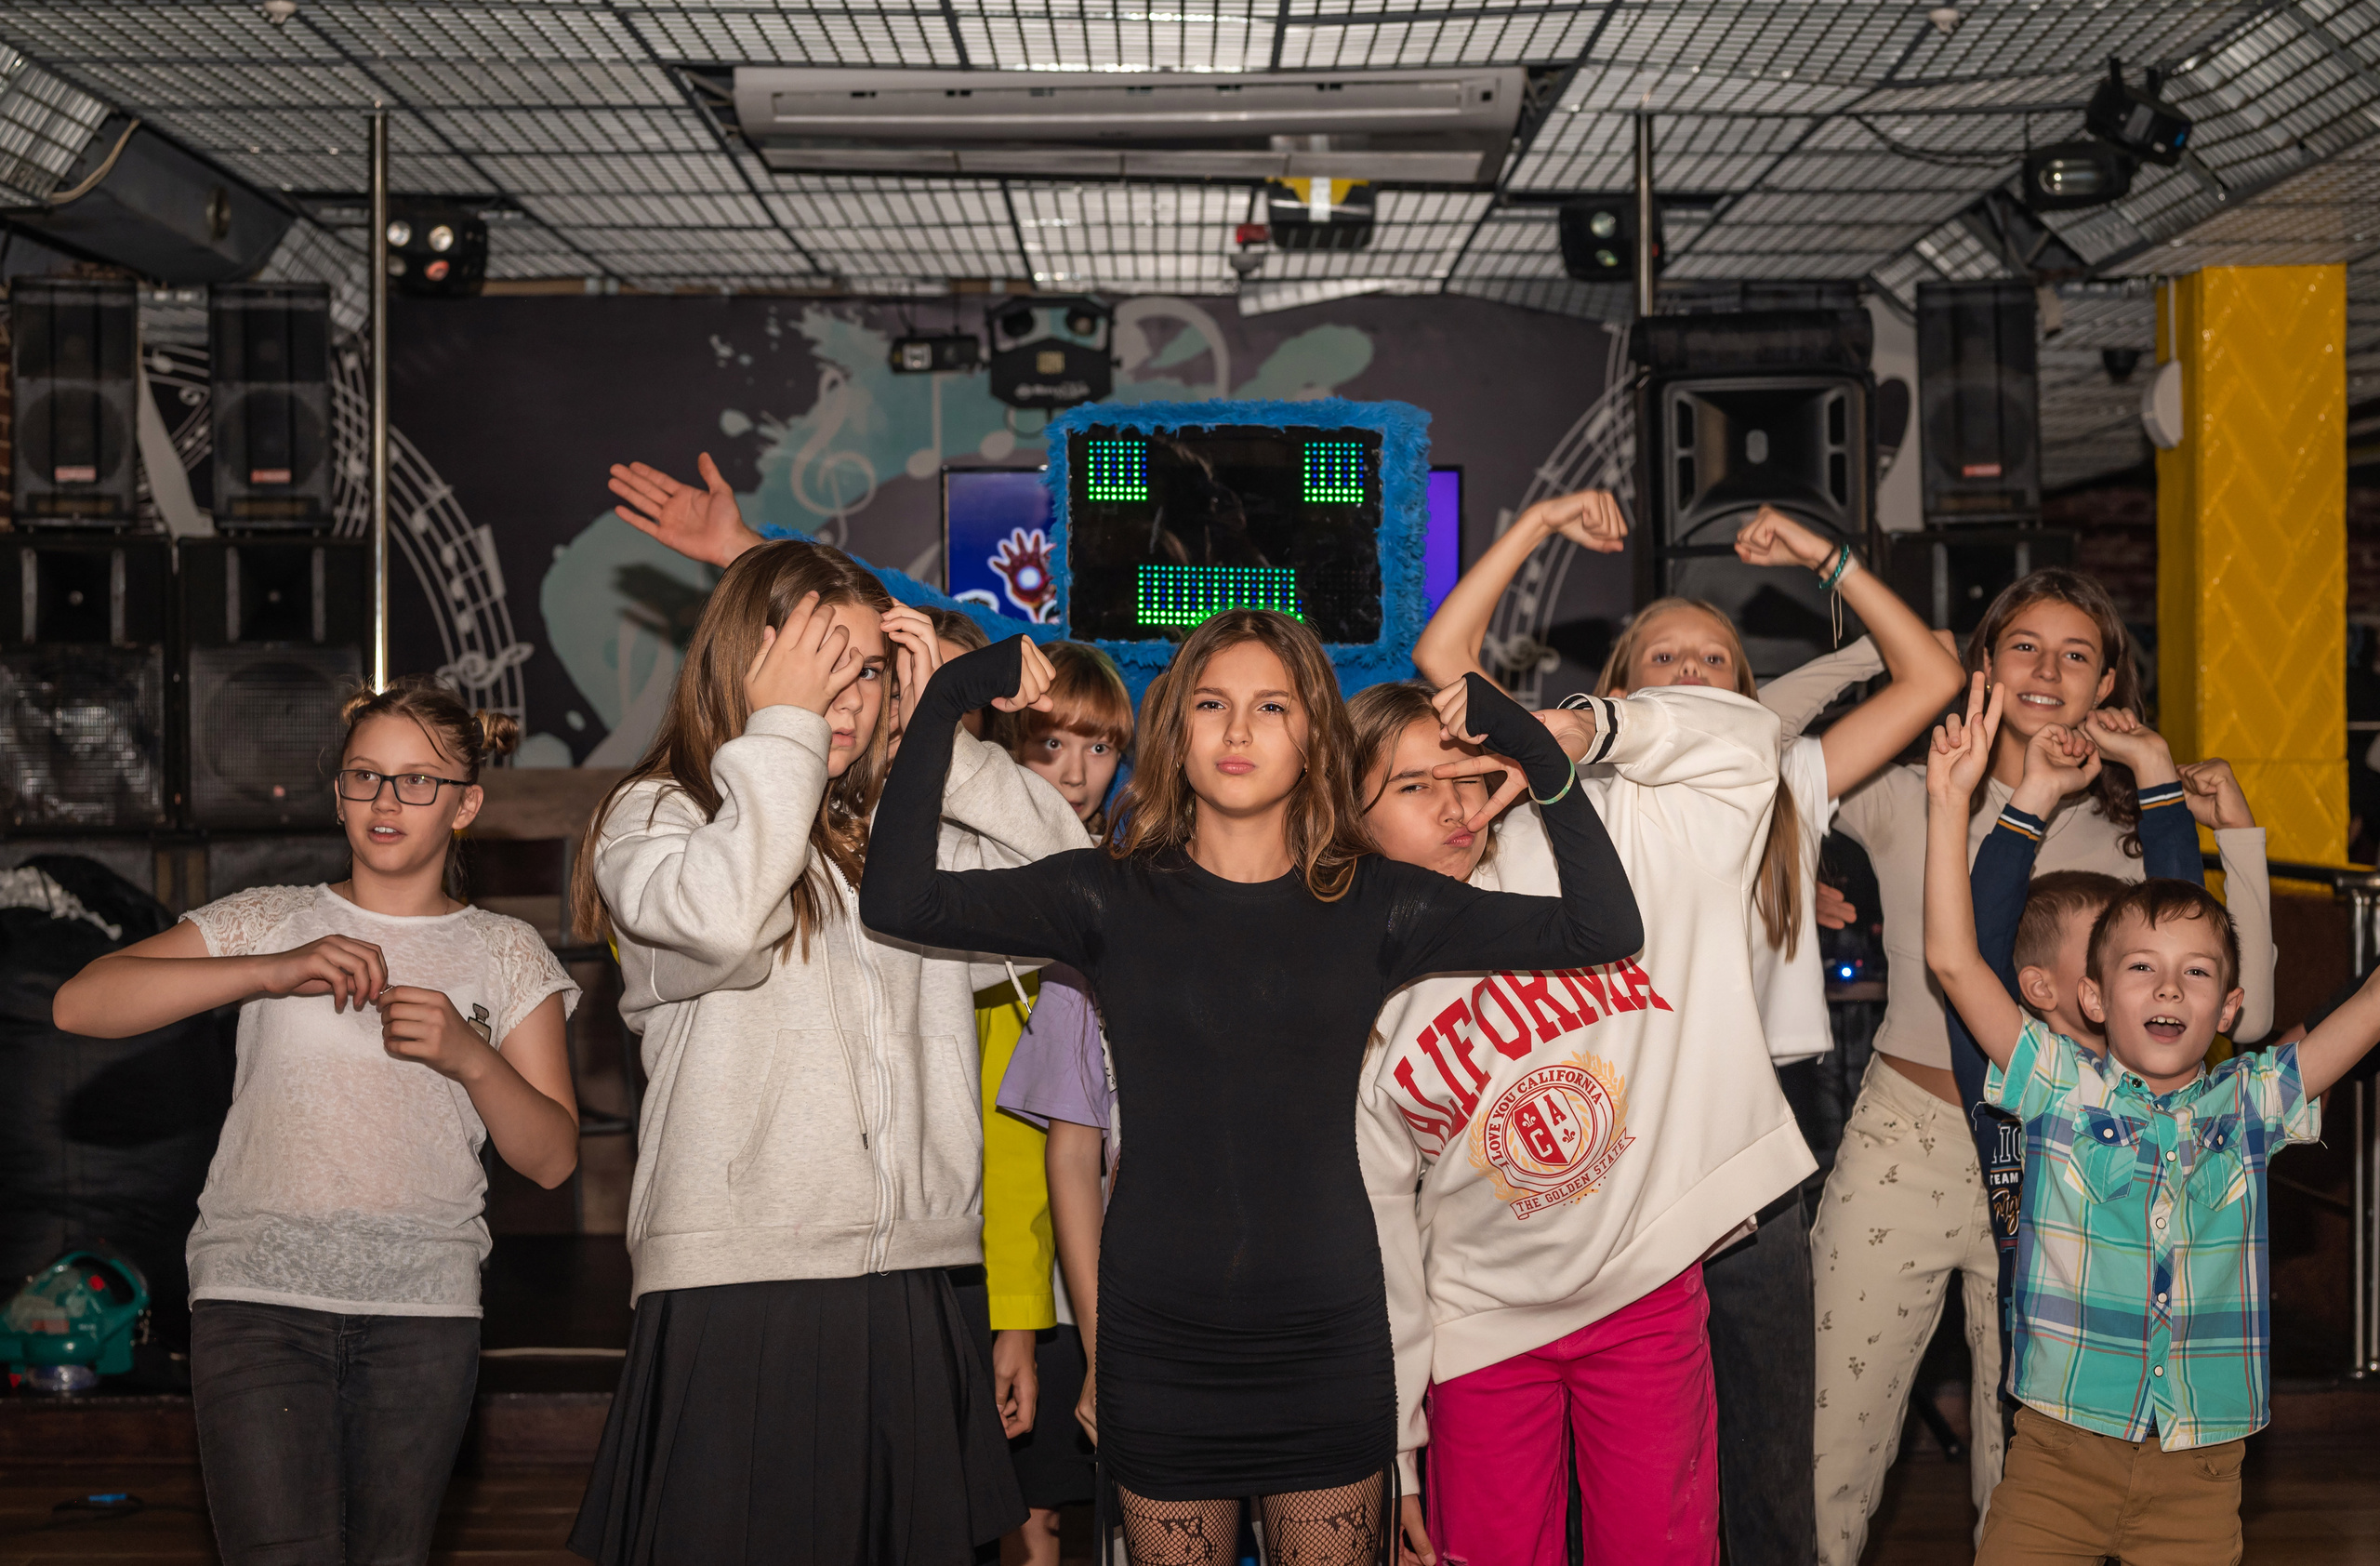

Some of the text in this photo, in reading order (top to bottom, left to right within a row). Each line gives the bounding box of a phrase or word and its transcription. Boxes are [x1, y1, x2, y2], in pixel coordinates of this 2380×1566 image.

[1393, 956, 1674, 1156] ALIFORNIA
[1517, 1069, 1603, 1105] CALIFORNIA
[1492, 1092, 1516, 1119] YOU
[1542, 1094, 1567, 1127] A
[1488, 1123, 1504, 1161] LOVE
[1529, 1128, 1554, 1158] C
[1516, 1139, 1625, 1212] THE GOLDEN STATE
